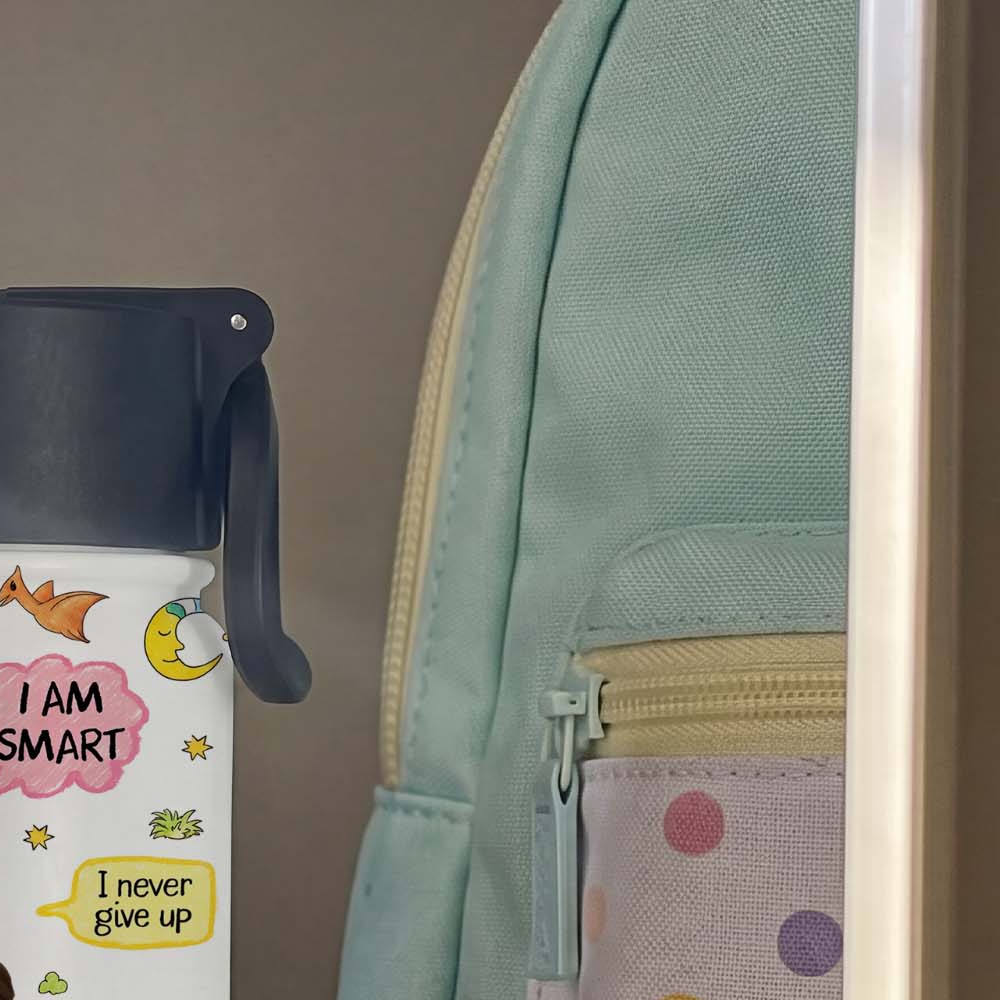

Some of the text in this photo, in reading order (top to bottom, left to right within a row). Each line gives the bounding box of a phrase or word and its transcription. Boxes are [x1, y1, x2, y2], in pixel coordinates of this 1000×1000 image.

[19, 681, 103, 715] I AM
[97, 869, 192, 898] I never
[94, 903, 192, 935] give up
